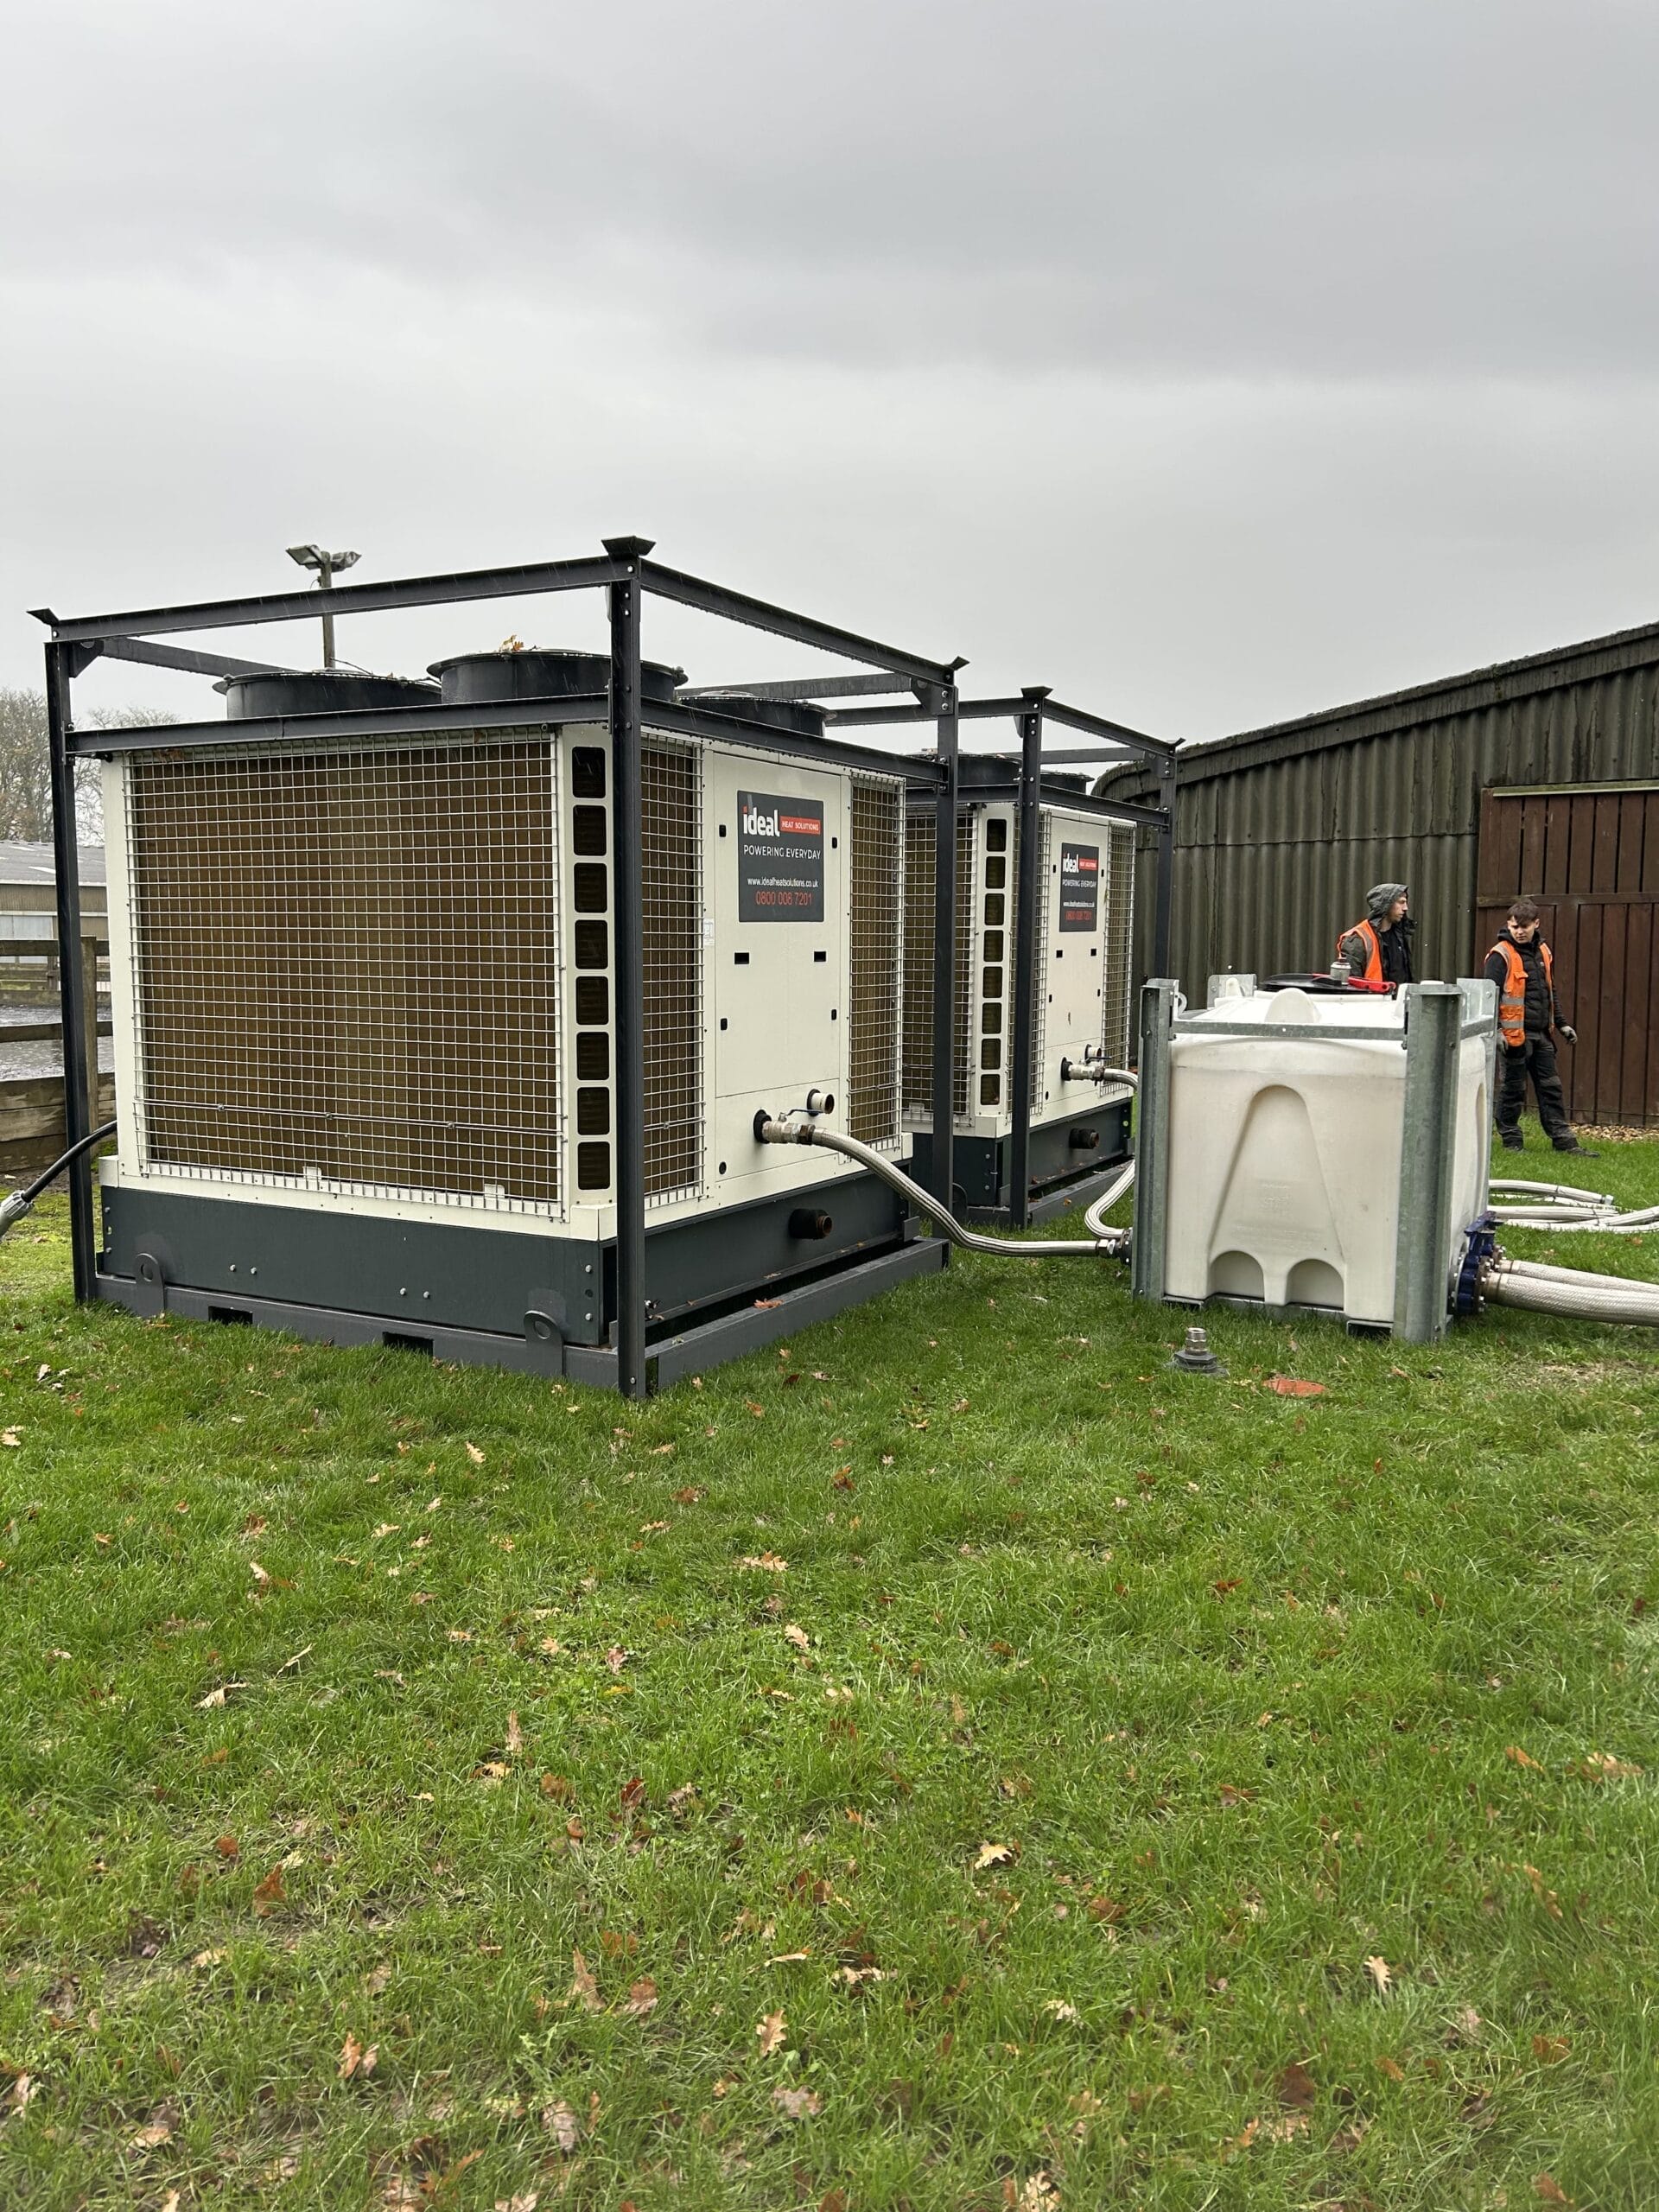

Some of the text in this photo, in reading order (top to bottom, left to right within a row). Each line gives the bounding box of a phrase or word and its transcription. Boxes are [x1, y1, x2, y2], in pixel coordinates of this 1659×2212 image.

[743, 805, 779, 836] ideal
[781, 820, 819, 831] HEAT SOLUTIONS
[743, 844, 821, 860] POWERING EVERYDAY
[1063, 853, 1079, 874] ideal
[747, 876, 819, 888] www.idealheatsolutions.co.uk
[755, 891, 813, 906] 0800 008 7201
